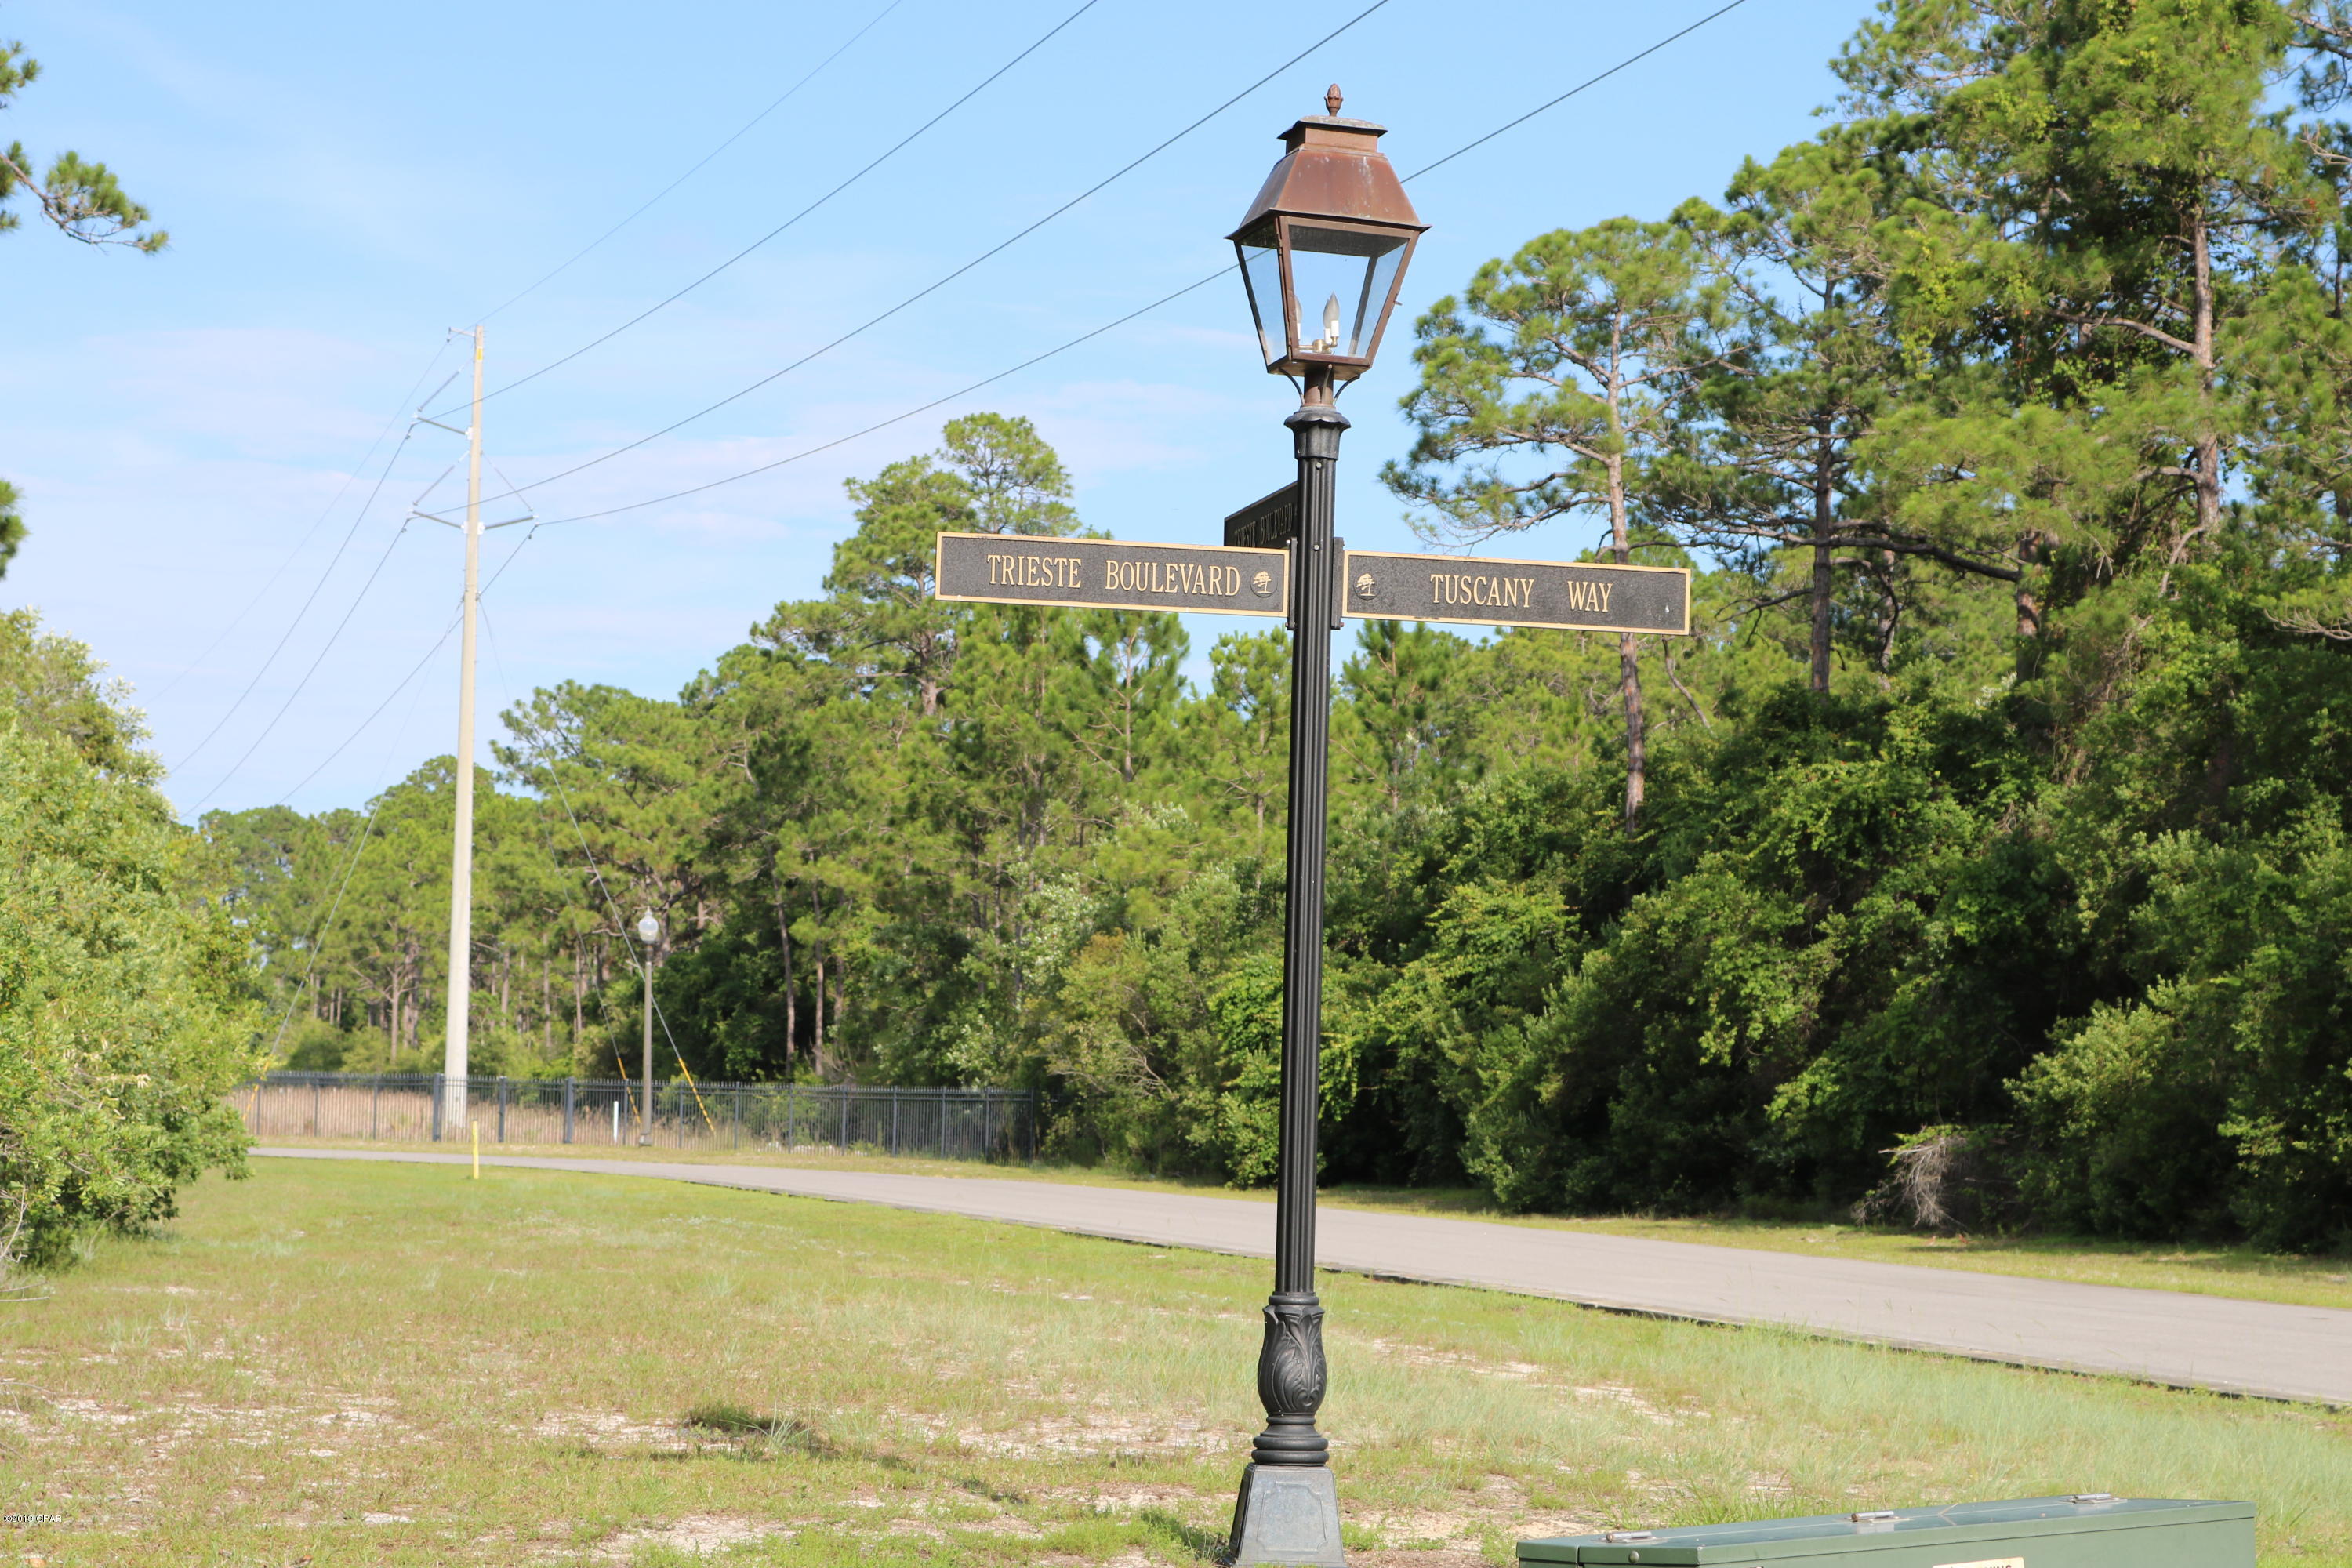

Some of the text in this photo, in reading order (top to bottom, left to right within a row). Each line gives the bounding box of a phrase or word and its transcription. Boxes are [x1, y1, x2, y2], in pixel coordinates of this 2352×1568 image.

[1260, 503, 1293, 545] BOULEVARD
[986, 554, 1241, 597] TRIESTE BOULEVARD
[1429, 574, 1613, 613] TUSCANY WAY
